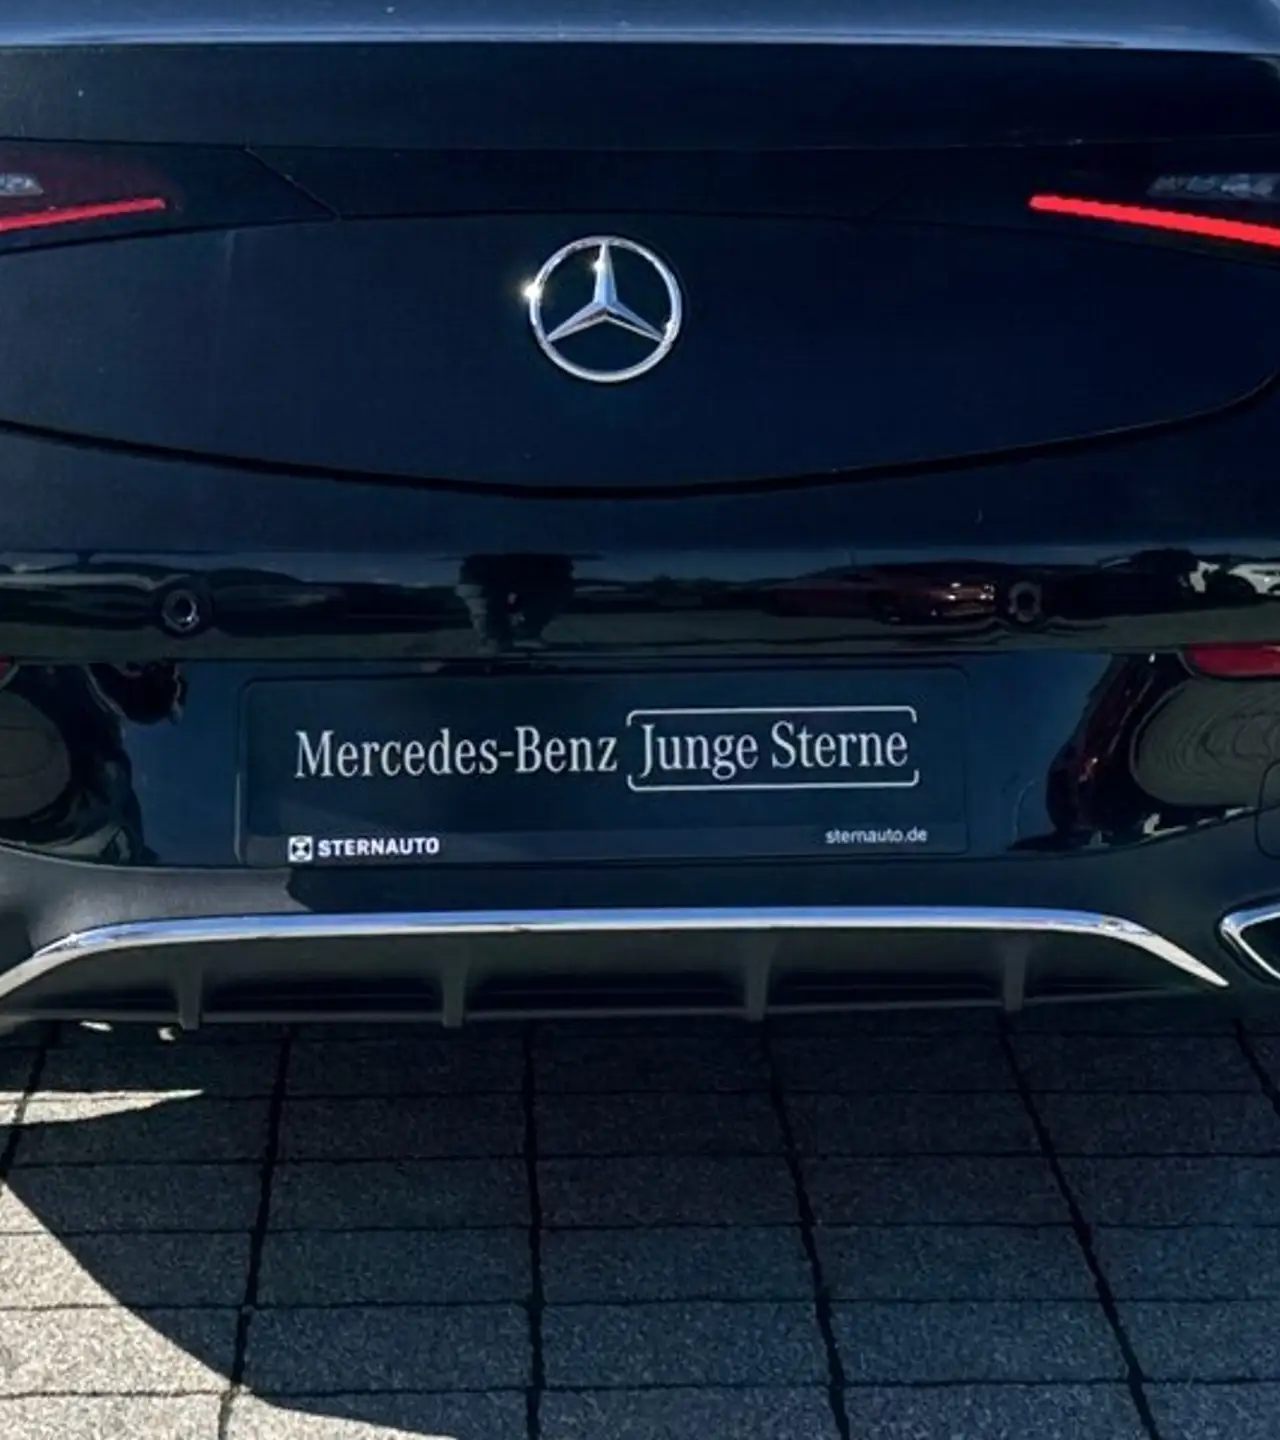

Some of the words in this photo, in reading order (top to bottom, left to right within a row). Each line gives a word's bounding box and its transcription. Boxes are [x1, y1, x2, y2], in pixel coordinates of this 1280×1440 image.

[294, 725, 618, 778] Mercedes-Benz
[639, 723, 759, 781] Junge
[770, 720, 909, 769] Sterne
[825, 825, 928, 845] sternauto.de
[317, 836, 440, 858] STERNAUTO
